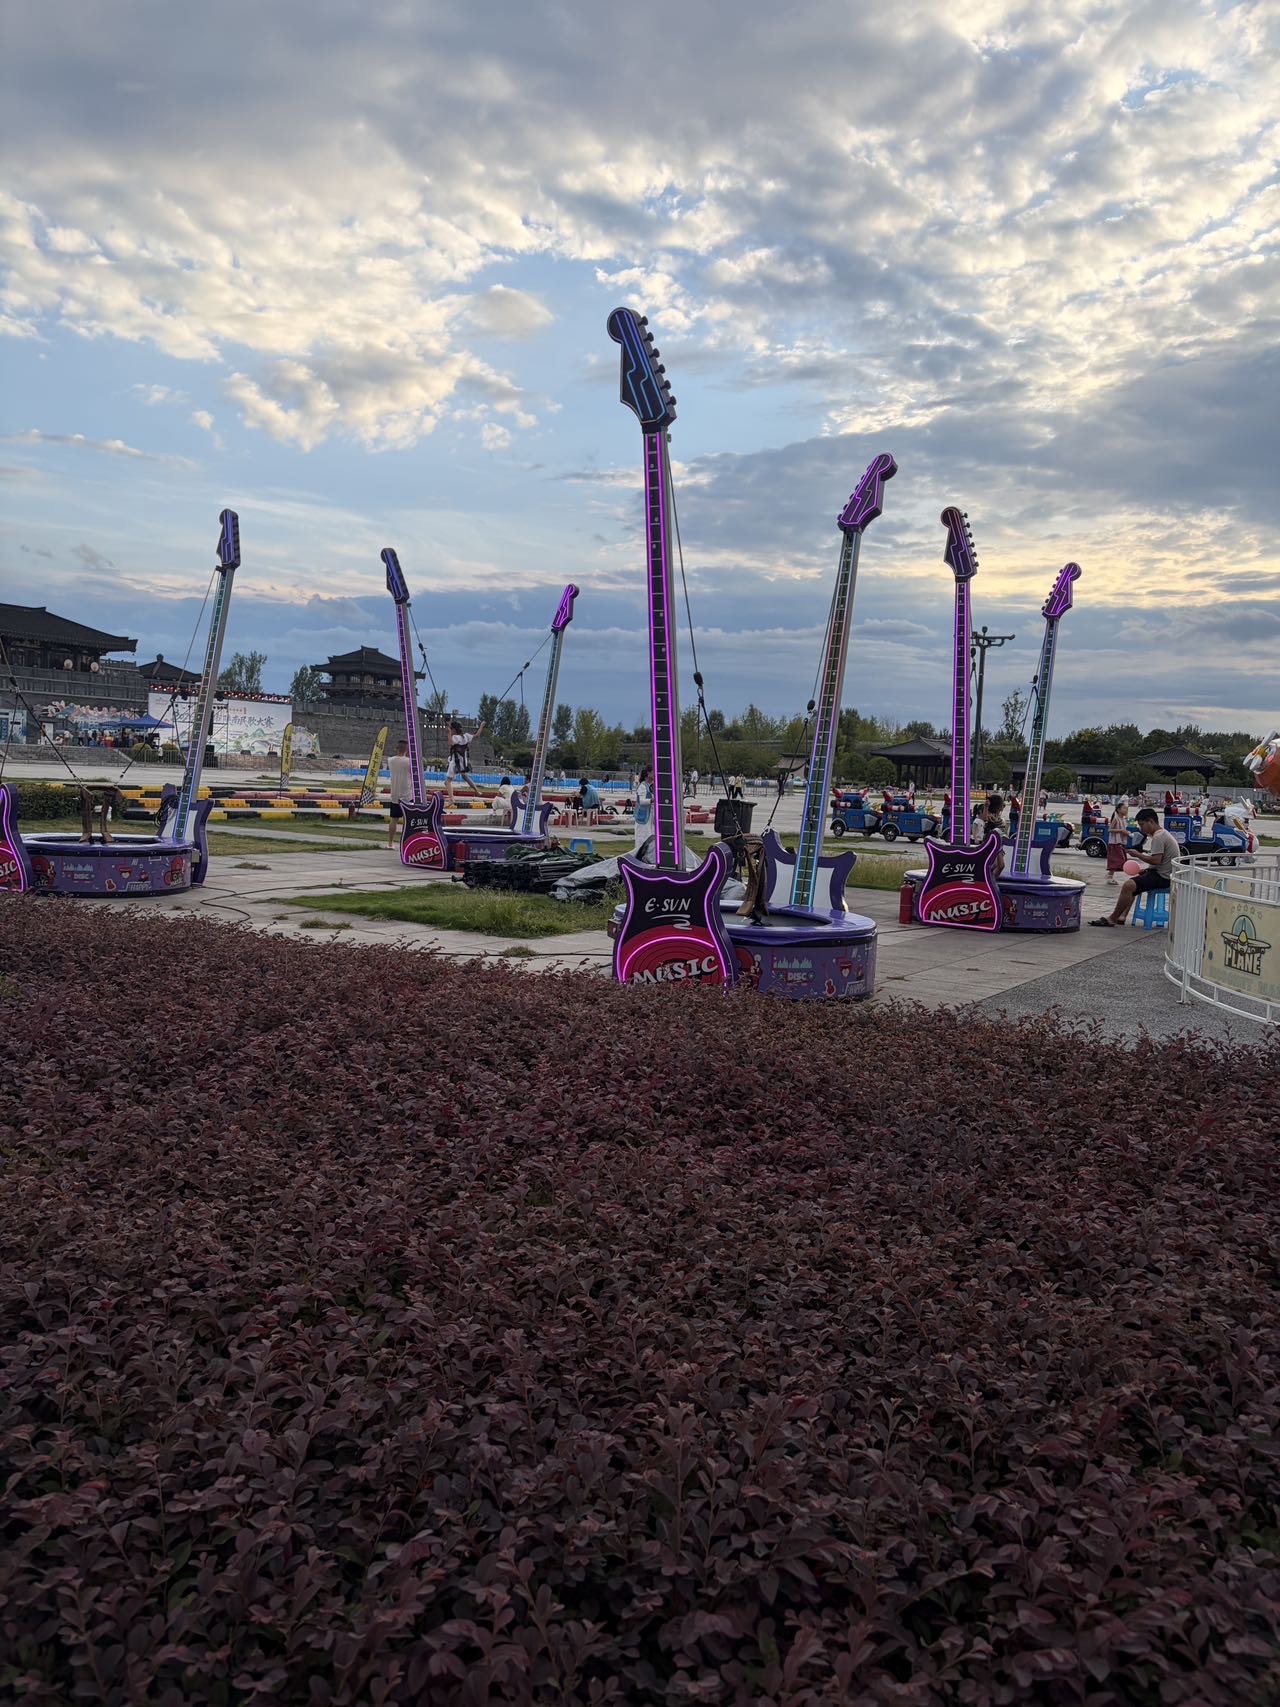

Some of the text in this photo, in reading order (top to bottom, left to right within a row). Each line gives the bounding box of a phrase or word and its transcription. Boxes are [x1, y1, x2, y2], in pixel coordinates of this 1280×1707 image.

[408, 846, 441, 863] MUSIC
[929, 900, 993, 921] MUSIC
[633, 955, 719, 985] MUSIC
[1225, 943, 1261, 976] PLANE
[787, 972, 808, 981] DISC
